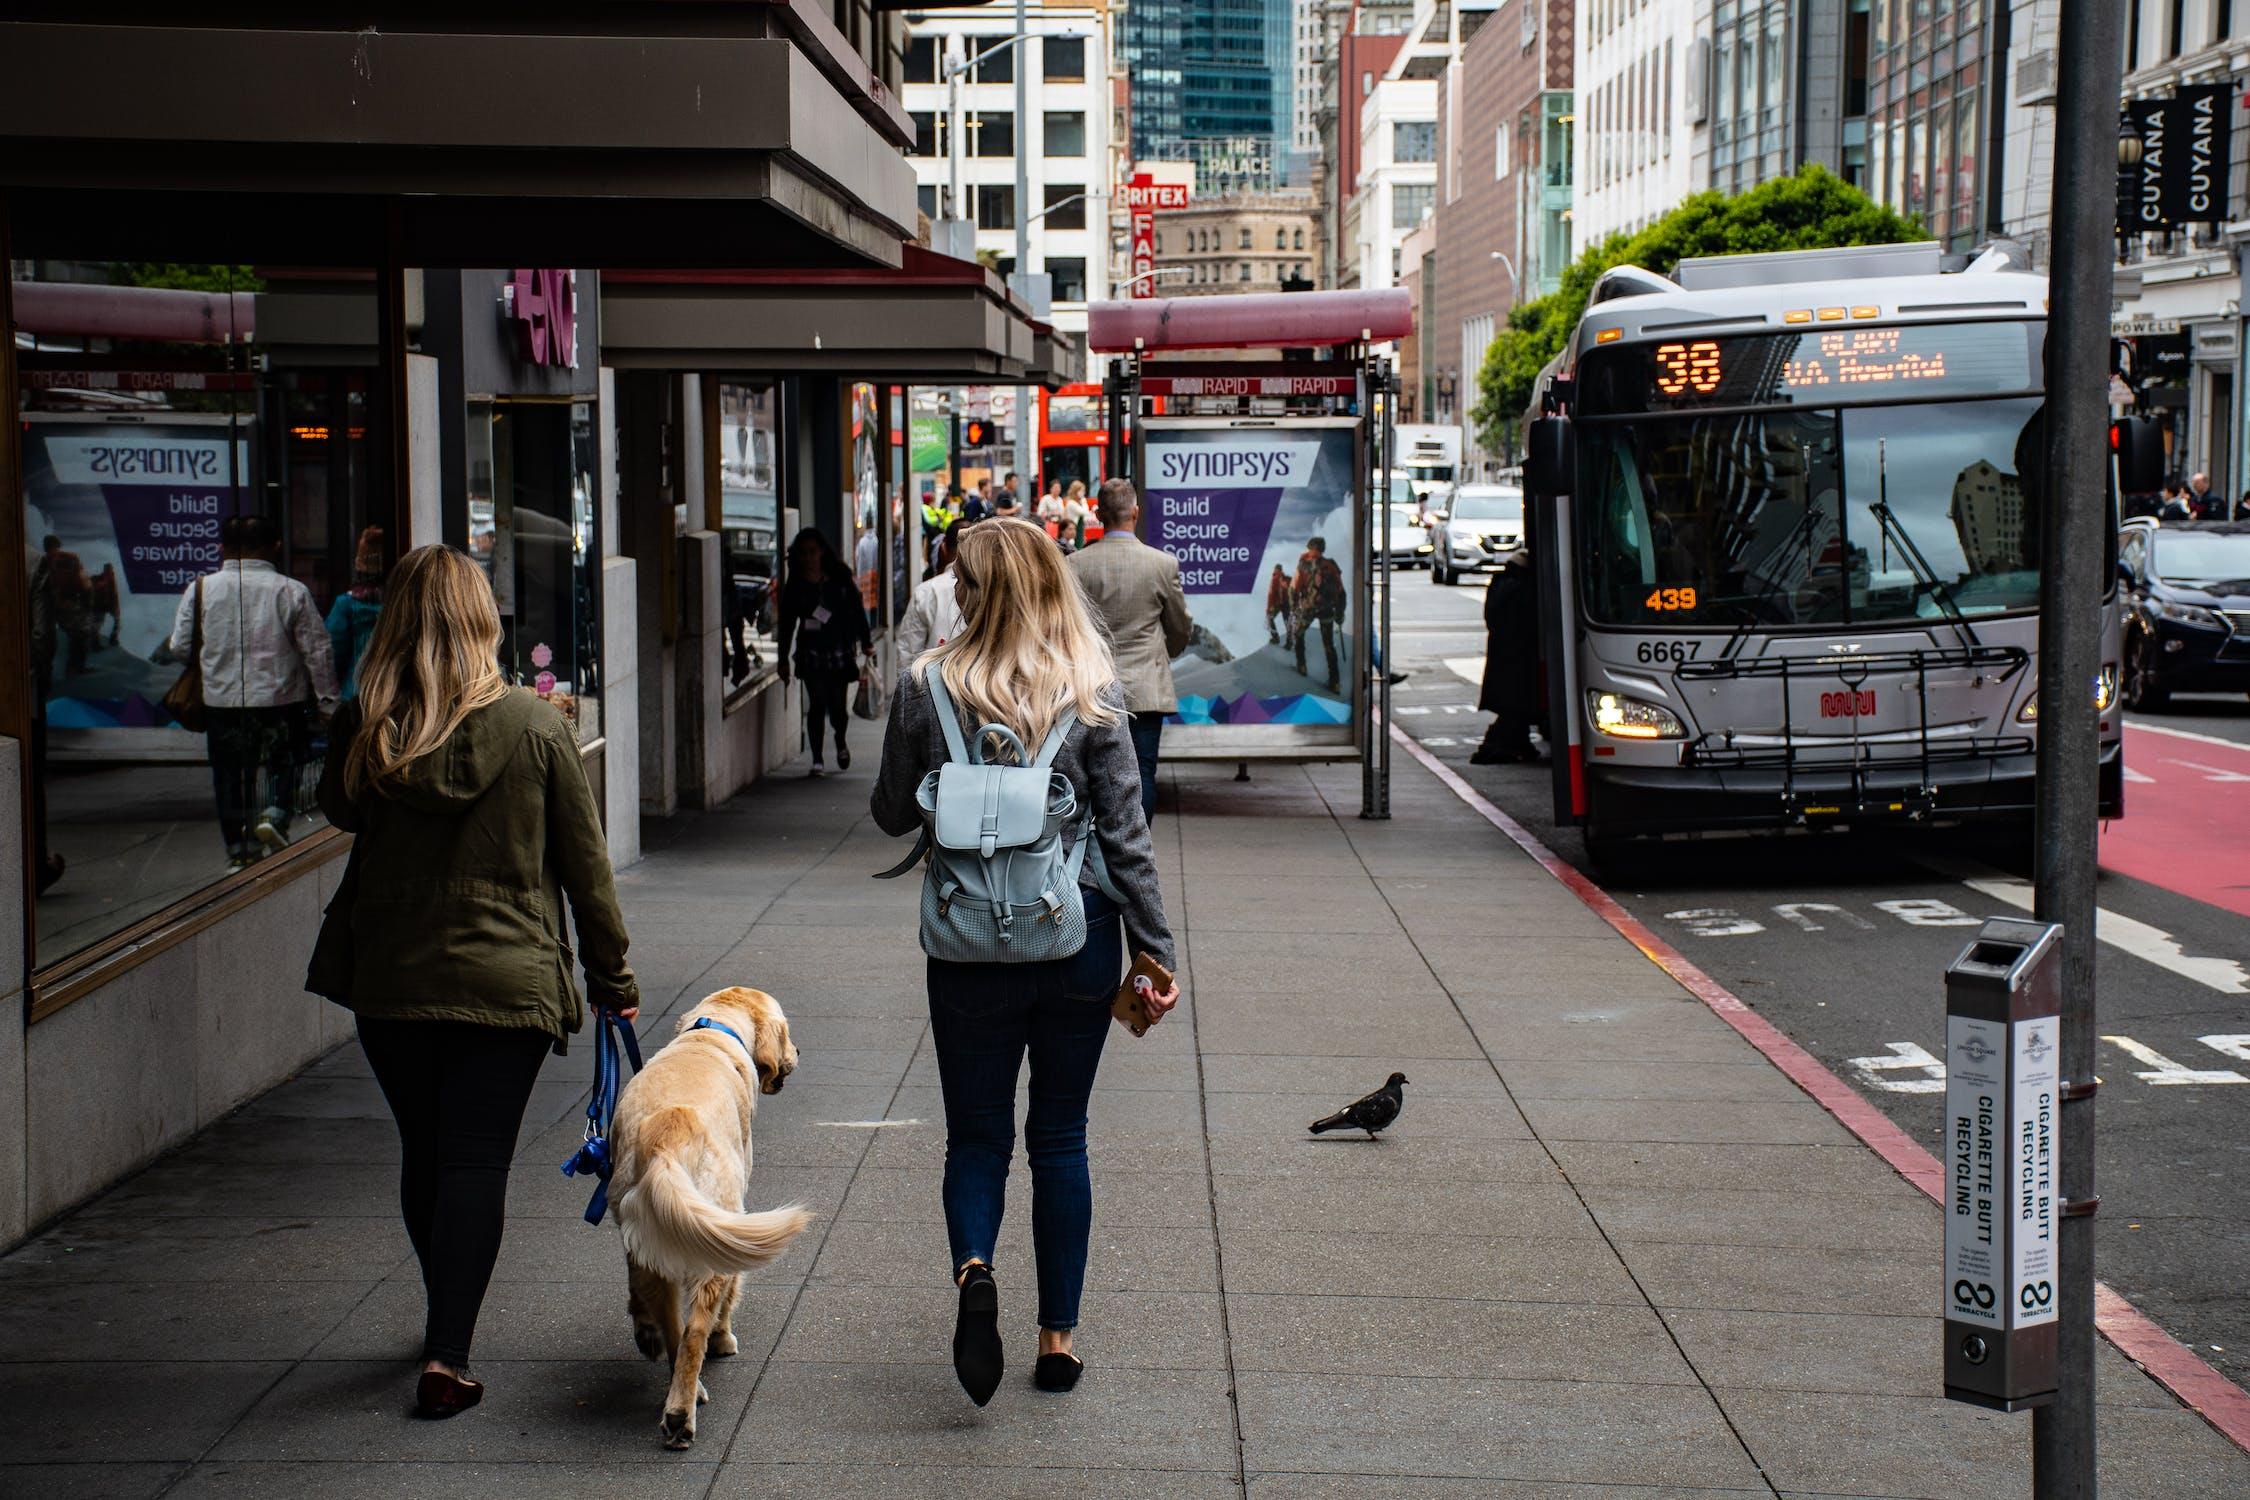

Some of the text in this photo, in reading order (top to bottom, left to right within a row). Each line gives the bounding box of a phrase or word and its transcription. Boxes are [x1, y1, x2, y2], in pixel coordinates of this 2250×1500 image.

[1228, 137, 1256, 155] THE
[2190, 95, 2214, 212] CUYANA
[1209, 157, 1271, 175] PALACE
[2141, 110, 2165, 222] CUYANA
[1117, 185, 1186, 207] BRITEX
[2112, 322, 2176, 333] POWELL
[1821, 330, 1899, 357] GEARY
[1656, 340, 1721, 393] 38
[1205, 378, 1249, 395] RAPID
[1293, 378, 1338, 395] RAPID
[1162, 497, 1210, 517] Build
[1162, 521, 1230, 540] Secure
[1163, 543, 1250, 563] Software
[1179, 568, 1223, 586] aster
[1645, 587, 1697, 611] 439
[1637, 641, 1702, 663] 6667
[1956, 1116, 1971, 1216] RECYCLING
[1977, 1095, 1993, 1245] CIGARETTE BUTT
[2022, 1120, 2034, 1220] RECYCLING
[2038, 1093, 2050, 1241] CIGARETTE BUTT
[1954, 1305, 1996, 1319] TERRACYCLE
[2020, 1307, 2052, 1318] TERRACYCLE
